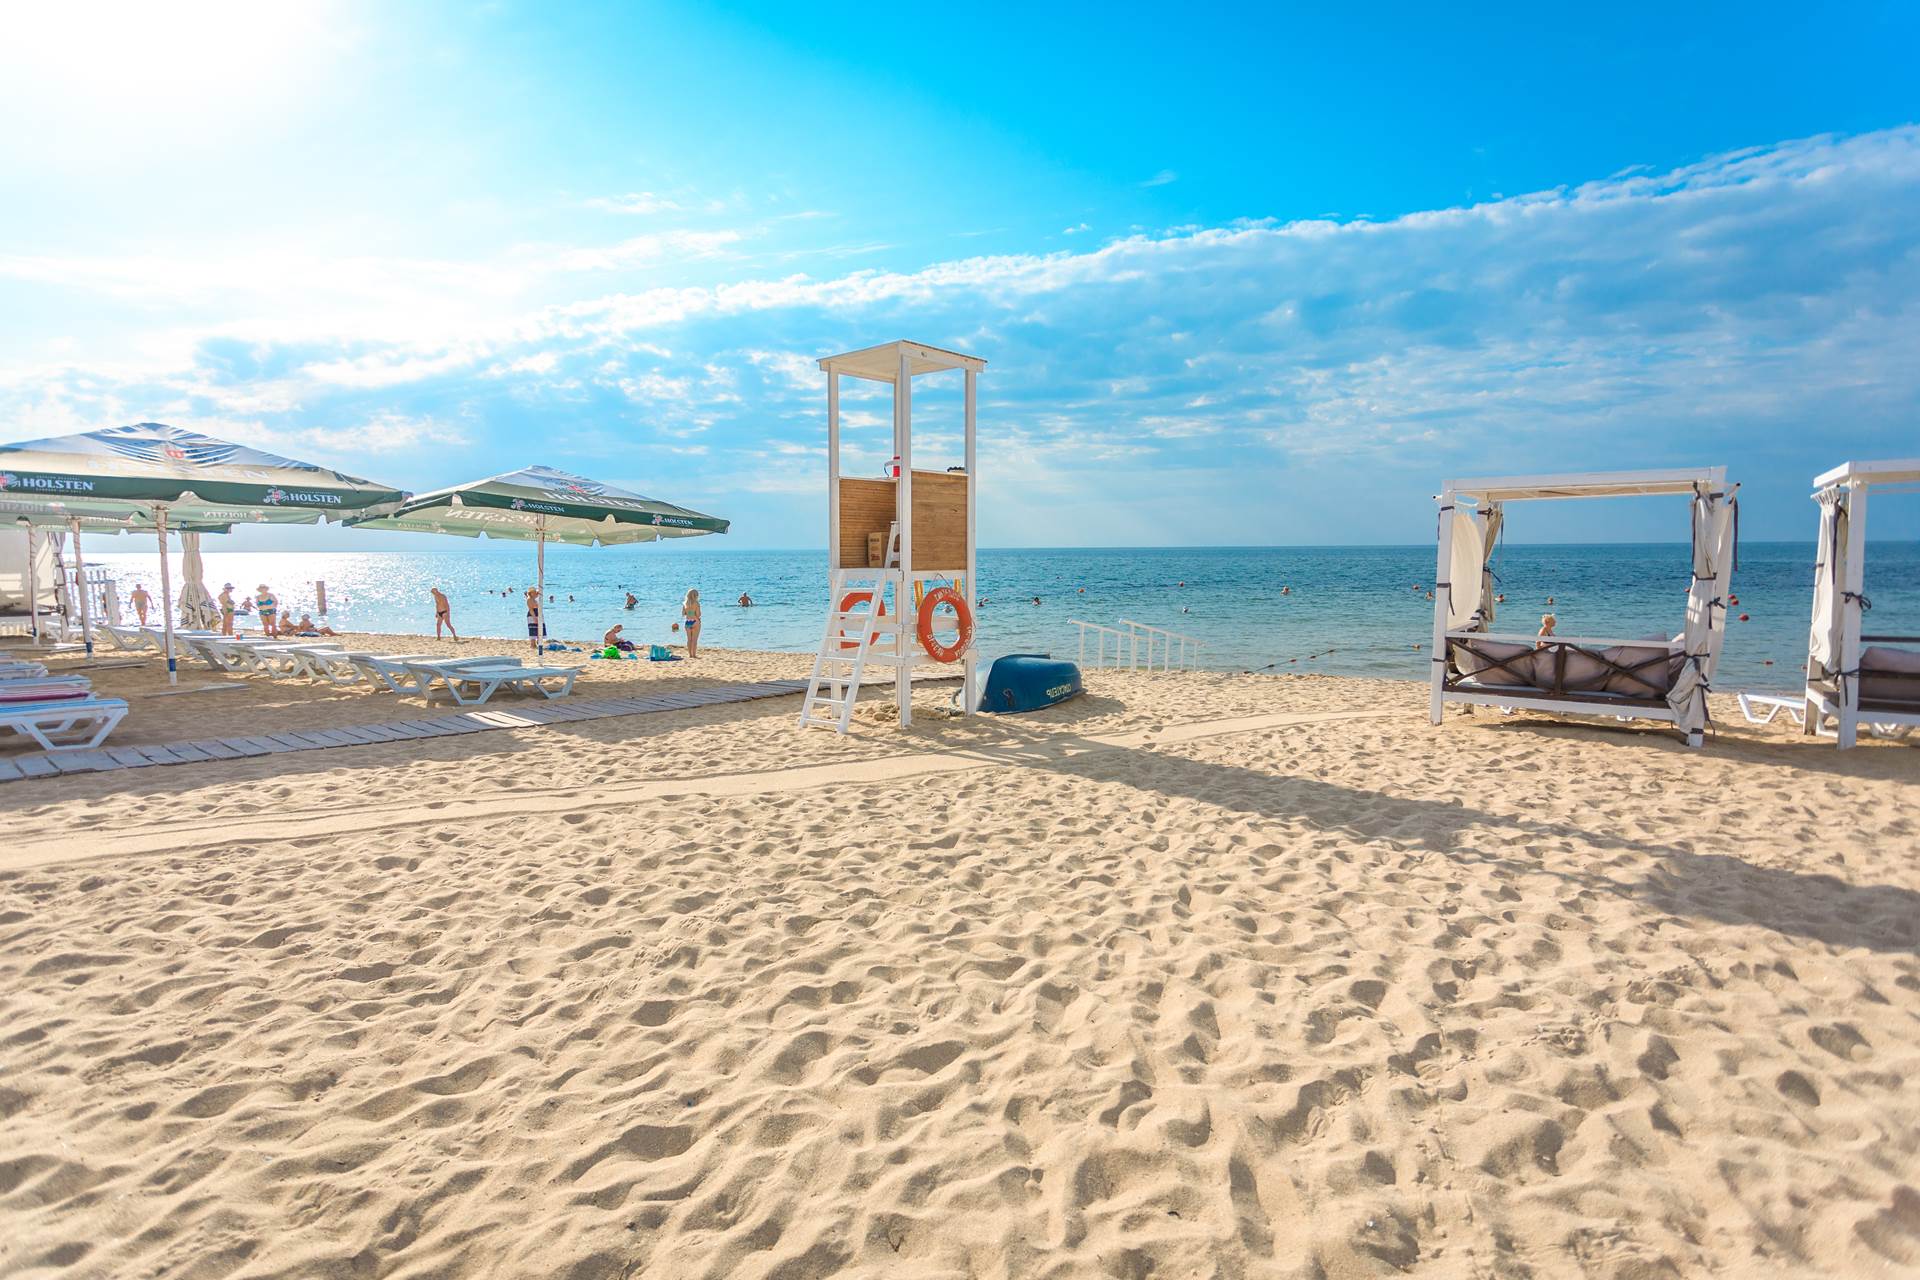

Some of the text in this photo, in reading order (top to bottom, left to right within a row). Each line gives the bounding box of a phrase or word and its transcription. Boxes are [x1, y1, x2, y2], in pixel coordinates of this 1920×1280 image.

[22, 477, 94, 491] HOLSTEN
[289, 492, 342, 504] HOLSTEN
[528, 503, 565, 513] HOLSTEN
